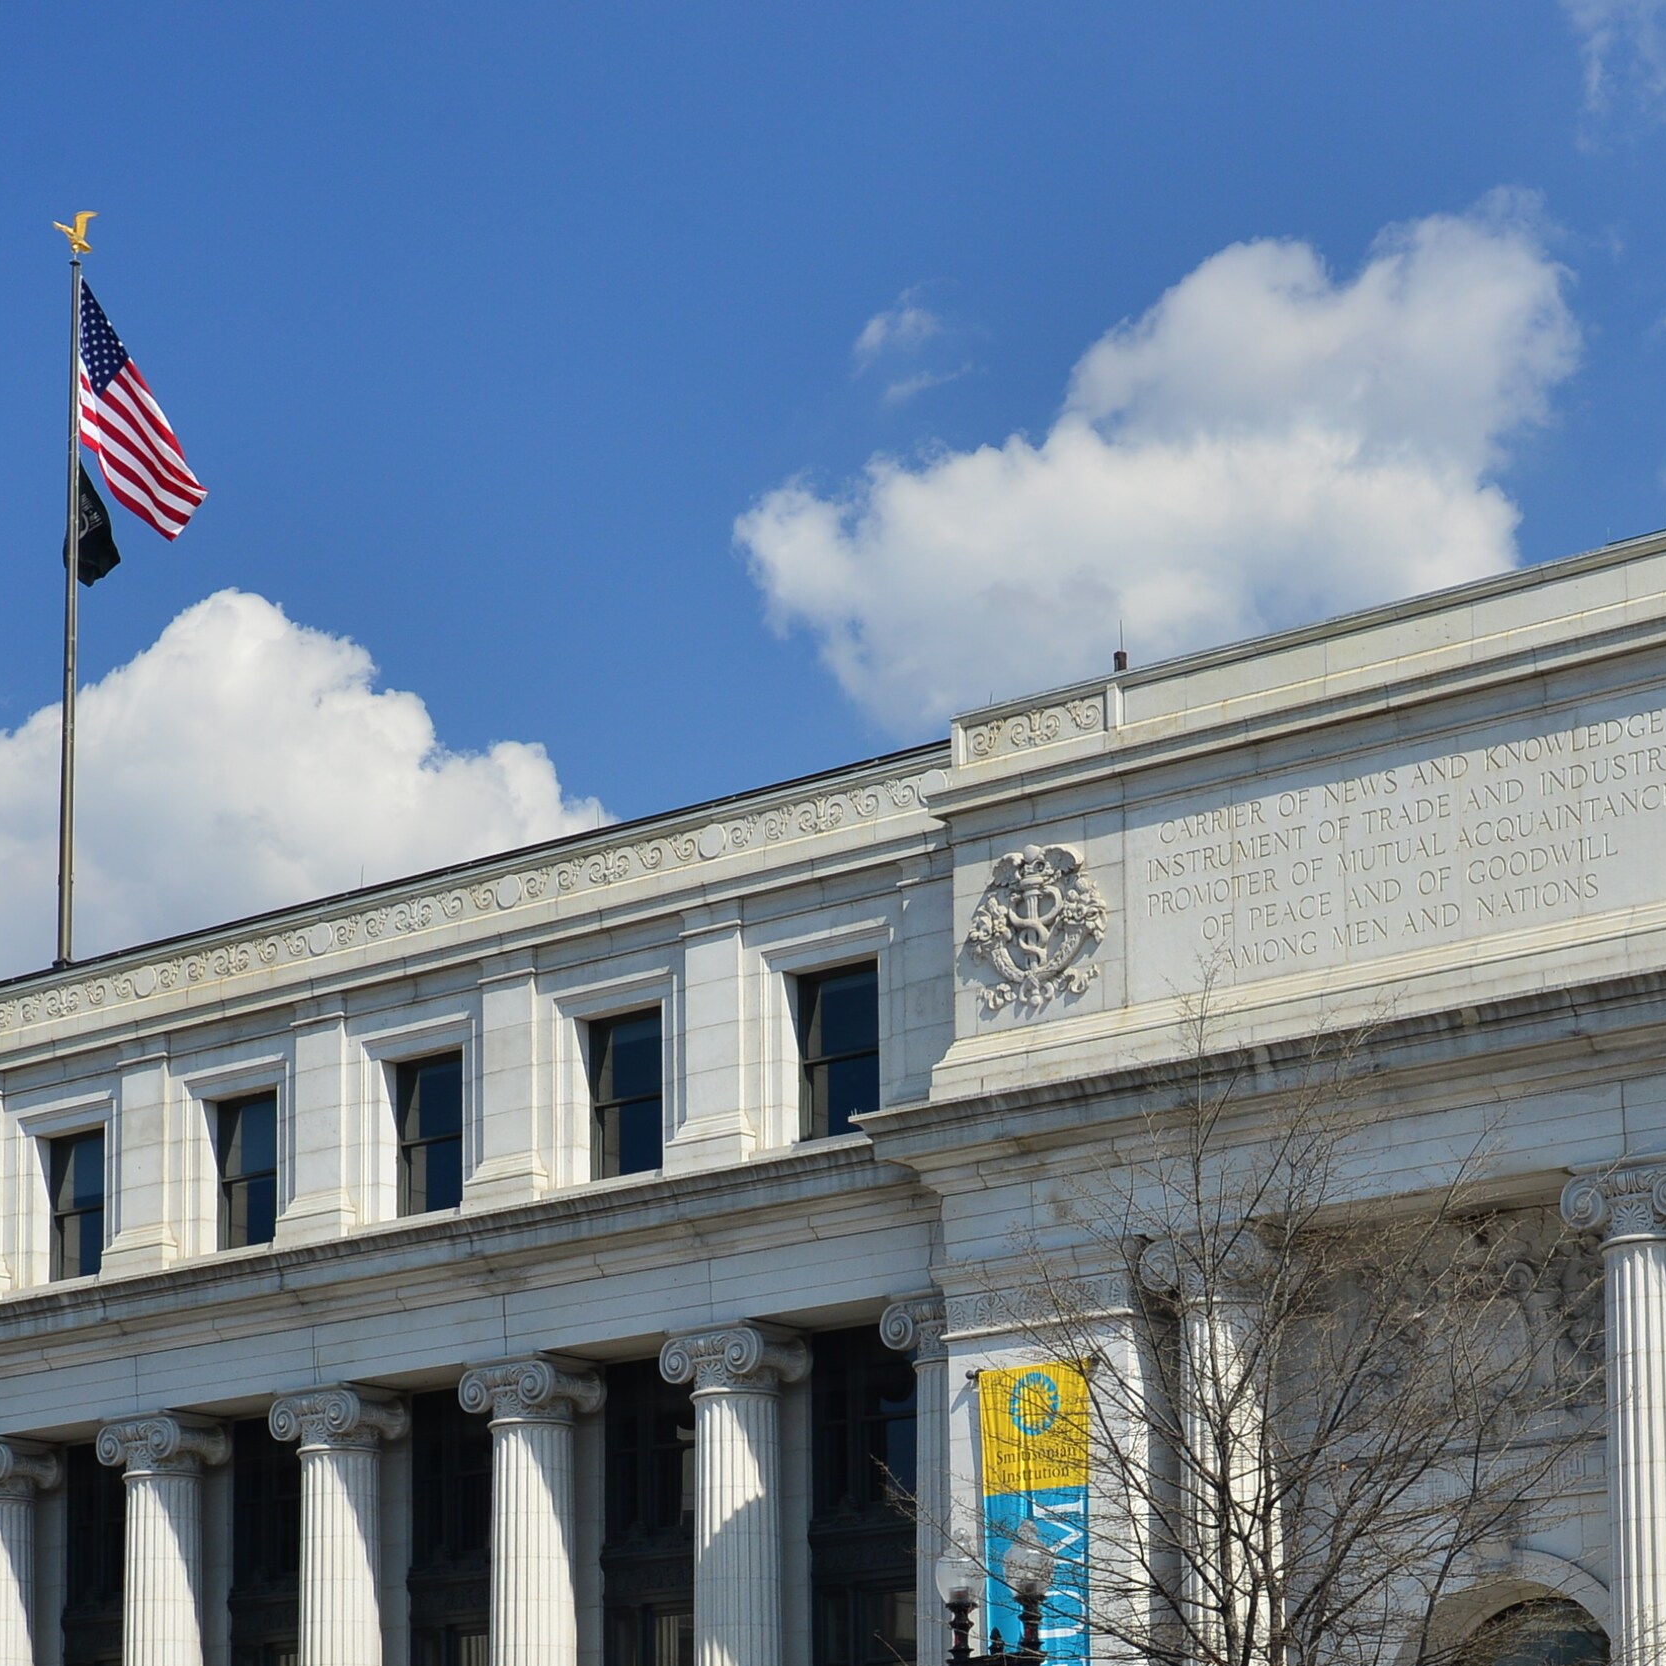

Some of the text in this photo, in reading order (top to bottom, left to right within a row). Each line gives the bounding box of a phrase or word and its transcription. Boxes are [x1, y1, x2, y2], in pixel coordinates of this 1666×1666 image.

[1159, 709, 1664, 845] CARRIER OF NEWS AND KNOWLEDGE
[1146, 826, 1306, 883] INSTRUMENT
[1317, 816, 1349, 844] OF
[1362, 794, 1451, 835] TRADE
[1462, 778, 1525, 814] AND
[1147, 868, 1279, 917] PROMOTER
[1291, 858, 1323, 886] OF
[1337, 833, 1446, 877] MUTUAL
[1201, 832, 1619, 941] OF PEACE AND OF GOODWILL
[1223, 873, 1599, 970] AMONG MEN AND NATIONS
